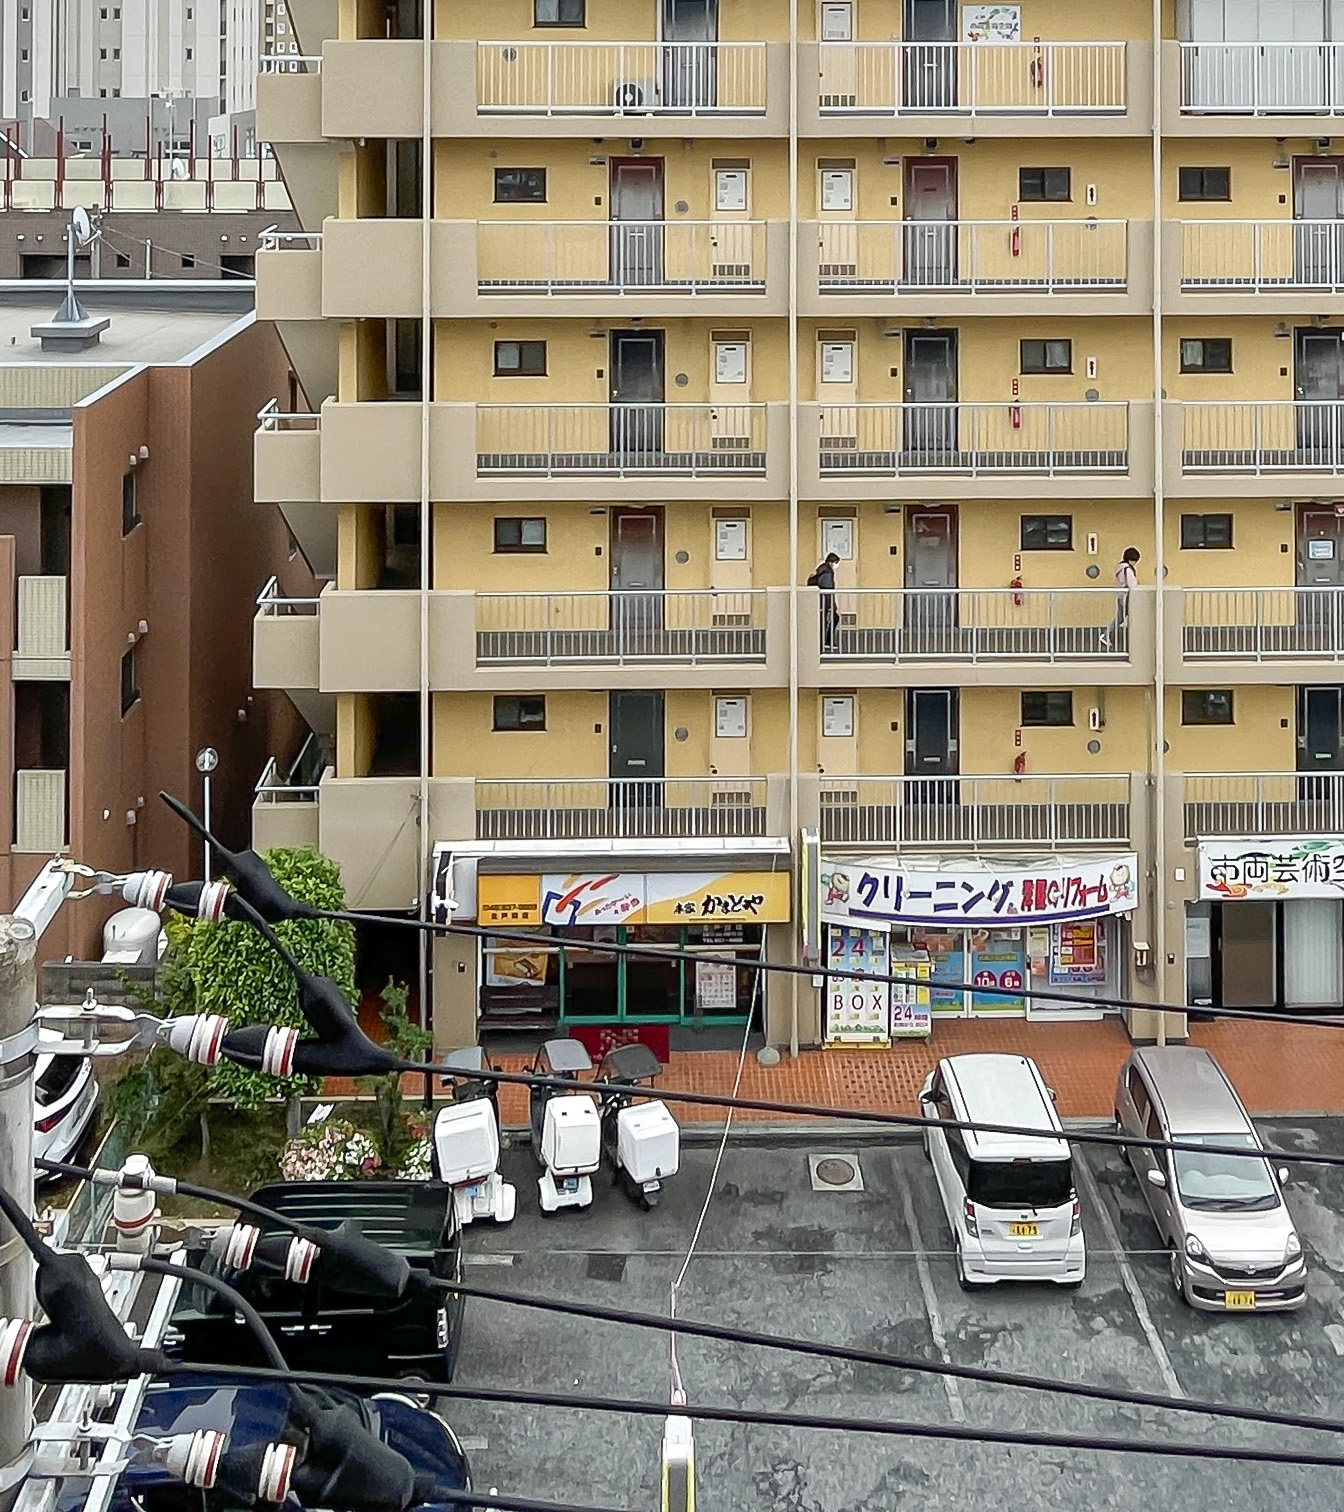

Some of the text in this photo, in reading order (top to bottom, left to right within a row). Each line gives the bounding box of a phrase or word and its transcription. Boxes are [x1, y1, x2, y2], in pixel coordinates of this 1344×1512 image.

[857, 872, 1014, 914] クリーニング
[834, 994, 883, 1011] BOX
